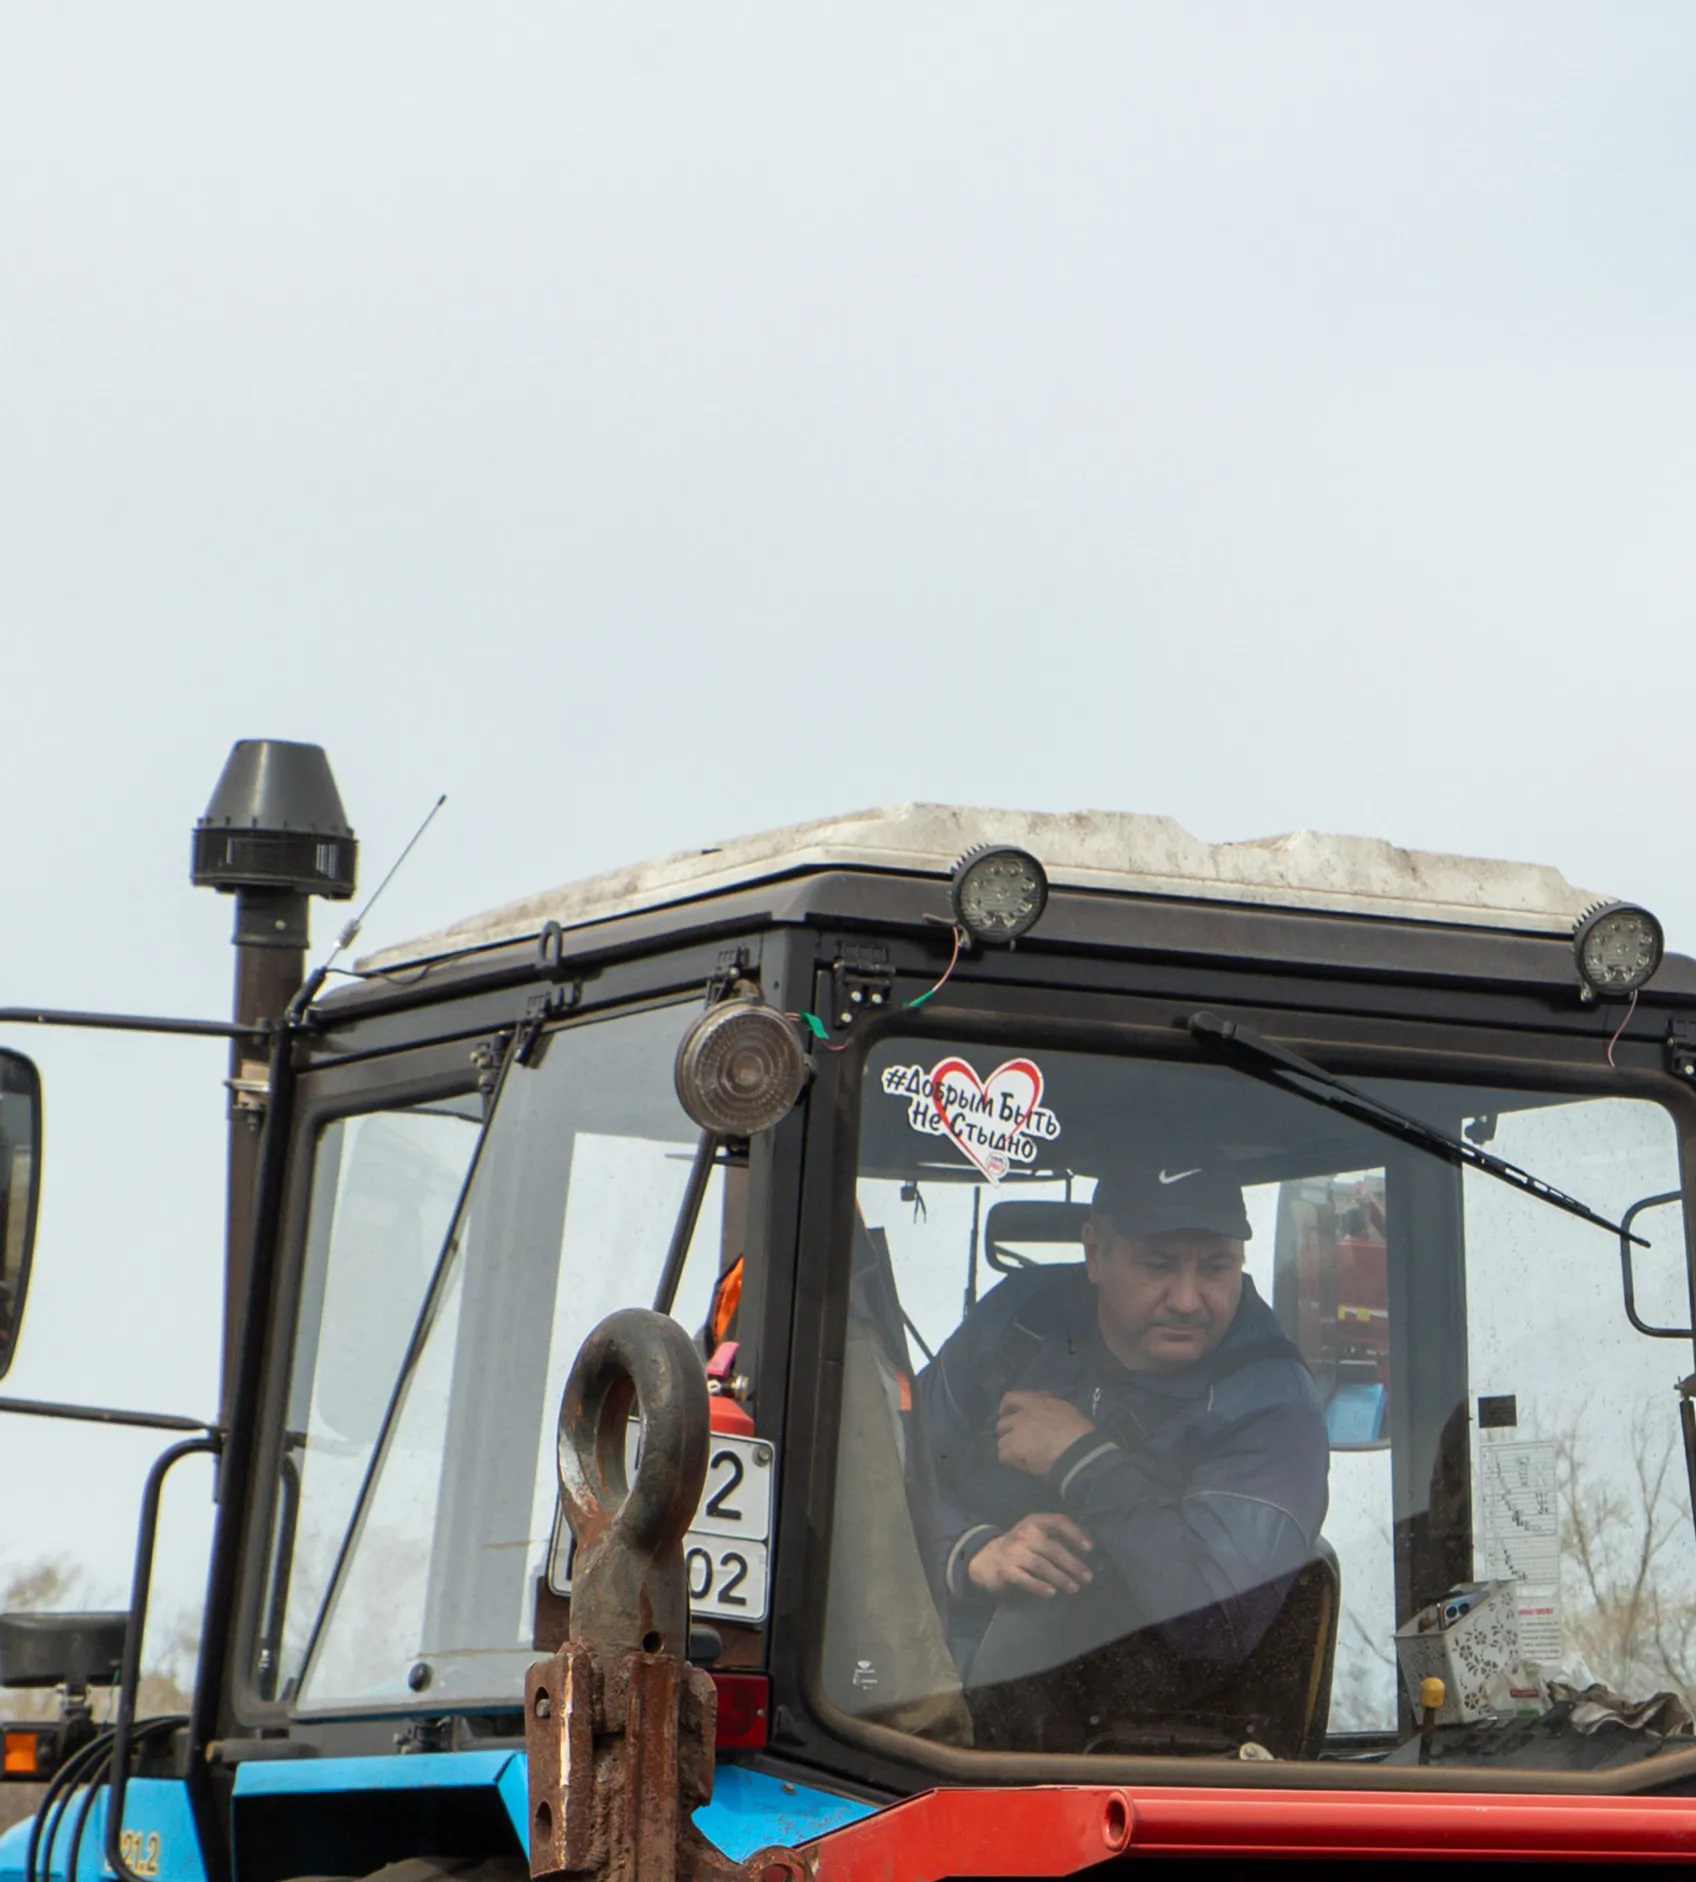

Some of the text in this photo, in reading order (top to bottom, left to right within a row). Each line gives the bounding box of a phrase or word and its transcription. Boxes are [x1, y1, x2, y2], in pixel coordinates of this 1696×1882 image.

[885, 1067, 1058, 1136] #Добрым Быть
[913, 1100, 1035, 1159] Не Стыдно
[685, 1547, 748, 1607] 02
